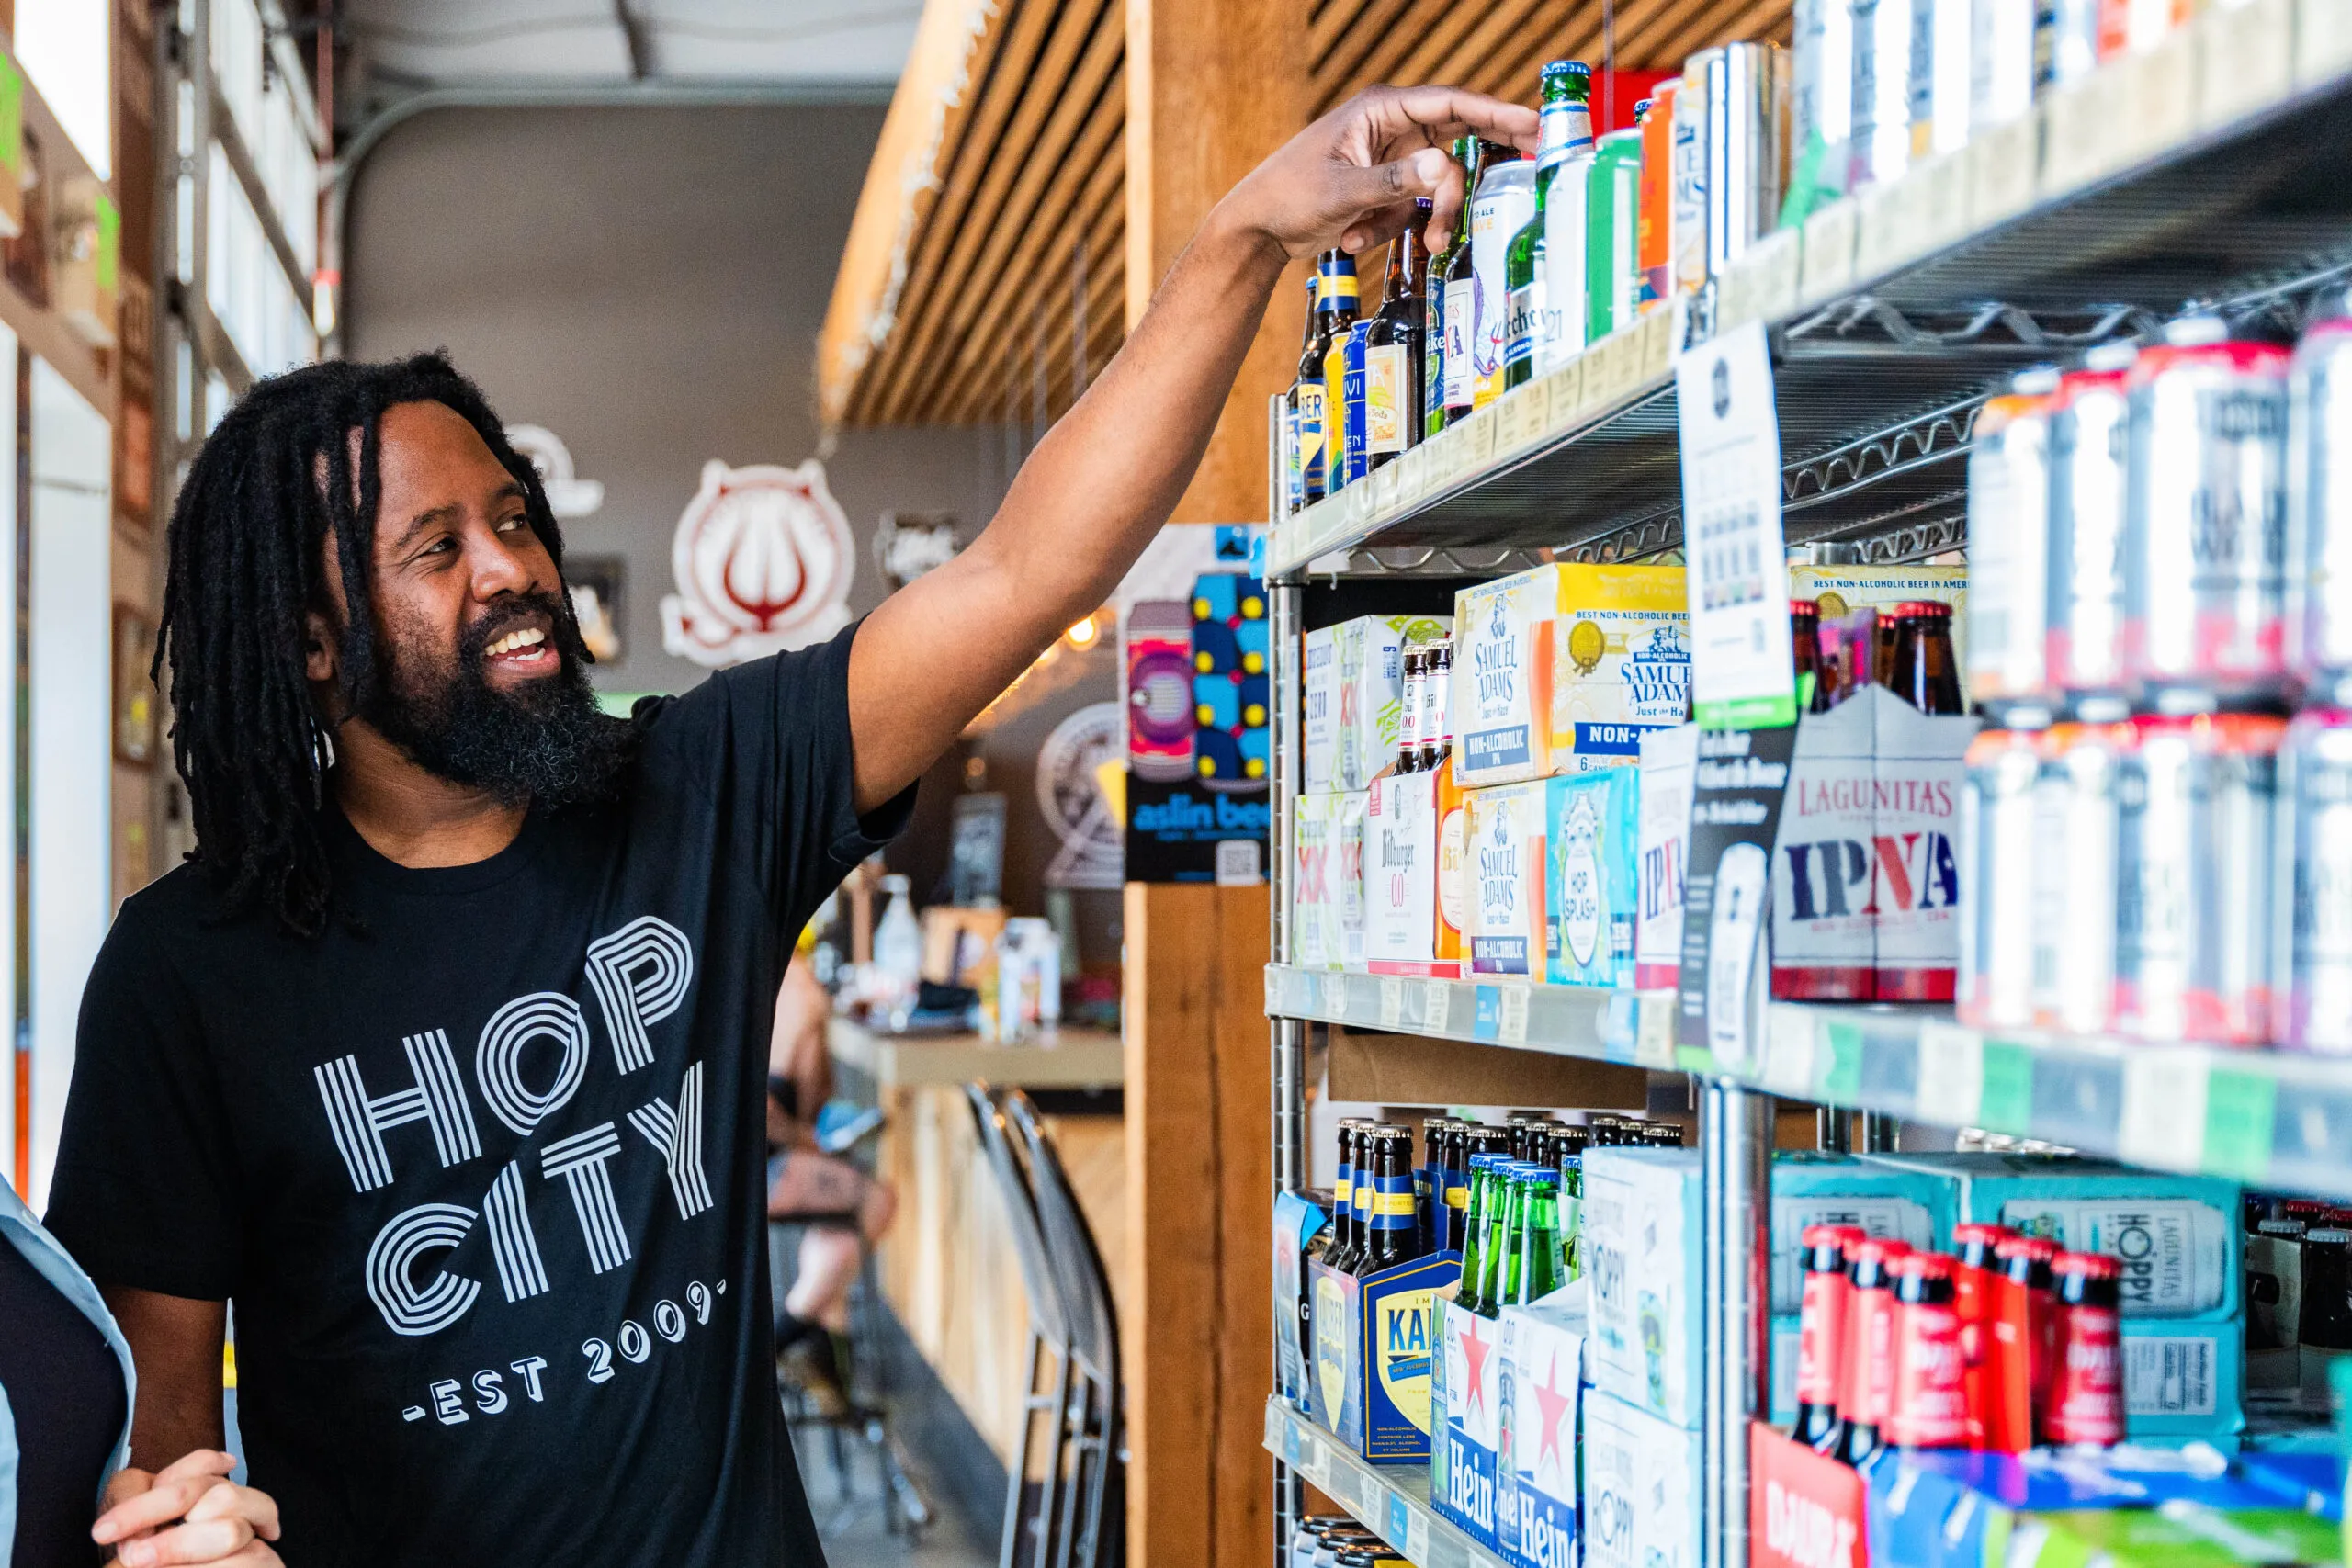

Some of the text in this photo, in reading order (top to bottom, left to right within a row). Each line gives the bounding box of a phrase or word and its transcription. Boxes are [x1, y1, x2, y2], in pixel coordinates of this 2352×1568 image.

[1481, 208, 1495, 216] ALE
[1814, 580, 1834, 588] BEST
[1837, 580, 1905, 589] NON-ALCOHOLIC
[1908, 581, 1929, 589] BEER
[1931, 581, 1941, 589] IN
[1576, 611, 1597, 619] BEST
[1600, 612, 1669, 620] NON-ALCOHOLIC
[1475, 635, 1518, 677] SAMUEL
[1621, 662, 1691, 685] SAMUE
[1478, 670, 1513, 709] ADAMS
[1629, 683, 1687, 706] ADAM
[1635, 706, 1657, 716] Just
[1670, 706, 1684, 716] Ha
[1469, 729, 1524, 755] NON-ALCOHOLIC
[1589, 726, 1656, 743] NON-A
[1580, 756, 1589, 772] 6
[1798, 779, 1953, 818] LAGUNITAS
[1381, 829, 1415, 872] Bitburger
[1442, 843, 1463, 872] Bi
[1480, 844, 1518, 881] SAMUEL
[1784, 830, 1959, 922] IPNA
[1482, 879, 1514, 913] ADAMS
[1564, 897, 1597, 922] SPLASH
[1475, 939, 1524, 959] NON-ALCOHOLIC
[314, 916, 694, 1193] HOP
[367, 1061, 714, 1336] CITY
[2117, 1213, 2153, 1303] HOPPY
[1449, 1438, 1495, 1533] Hein
